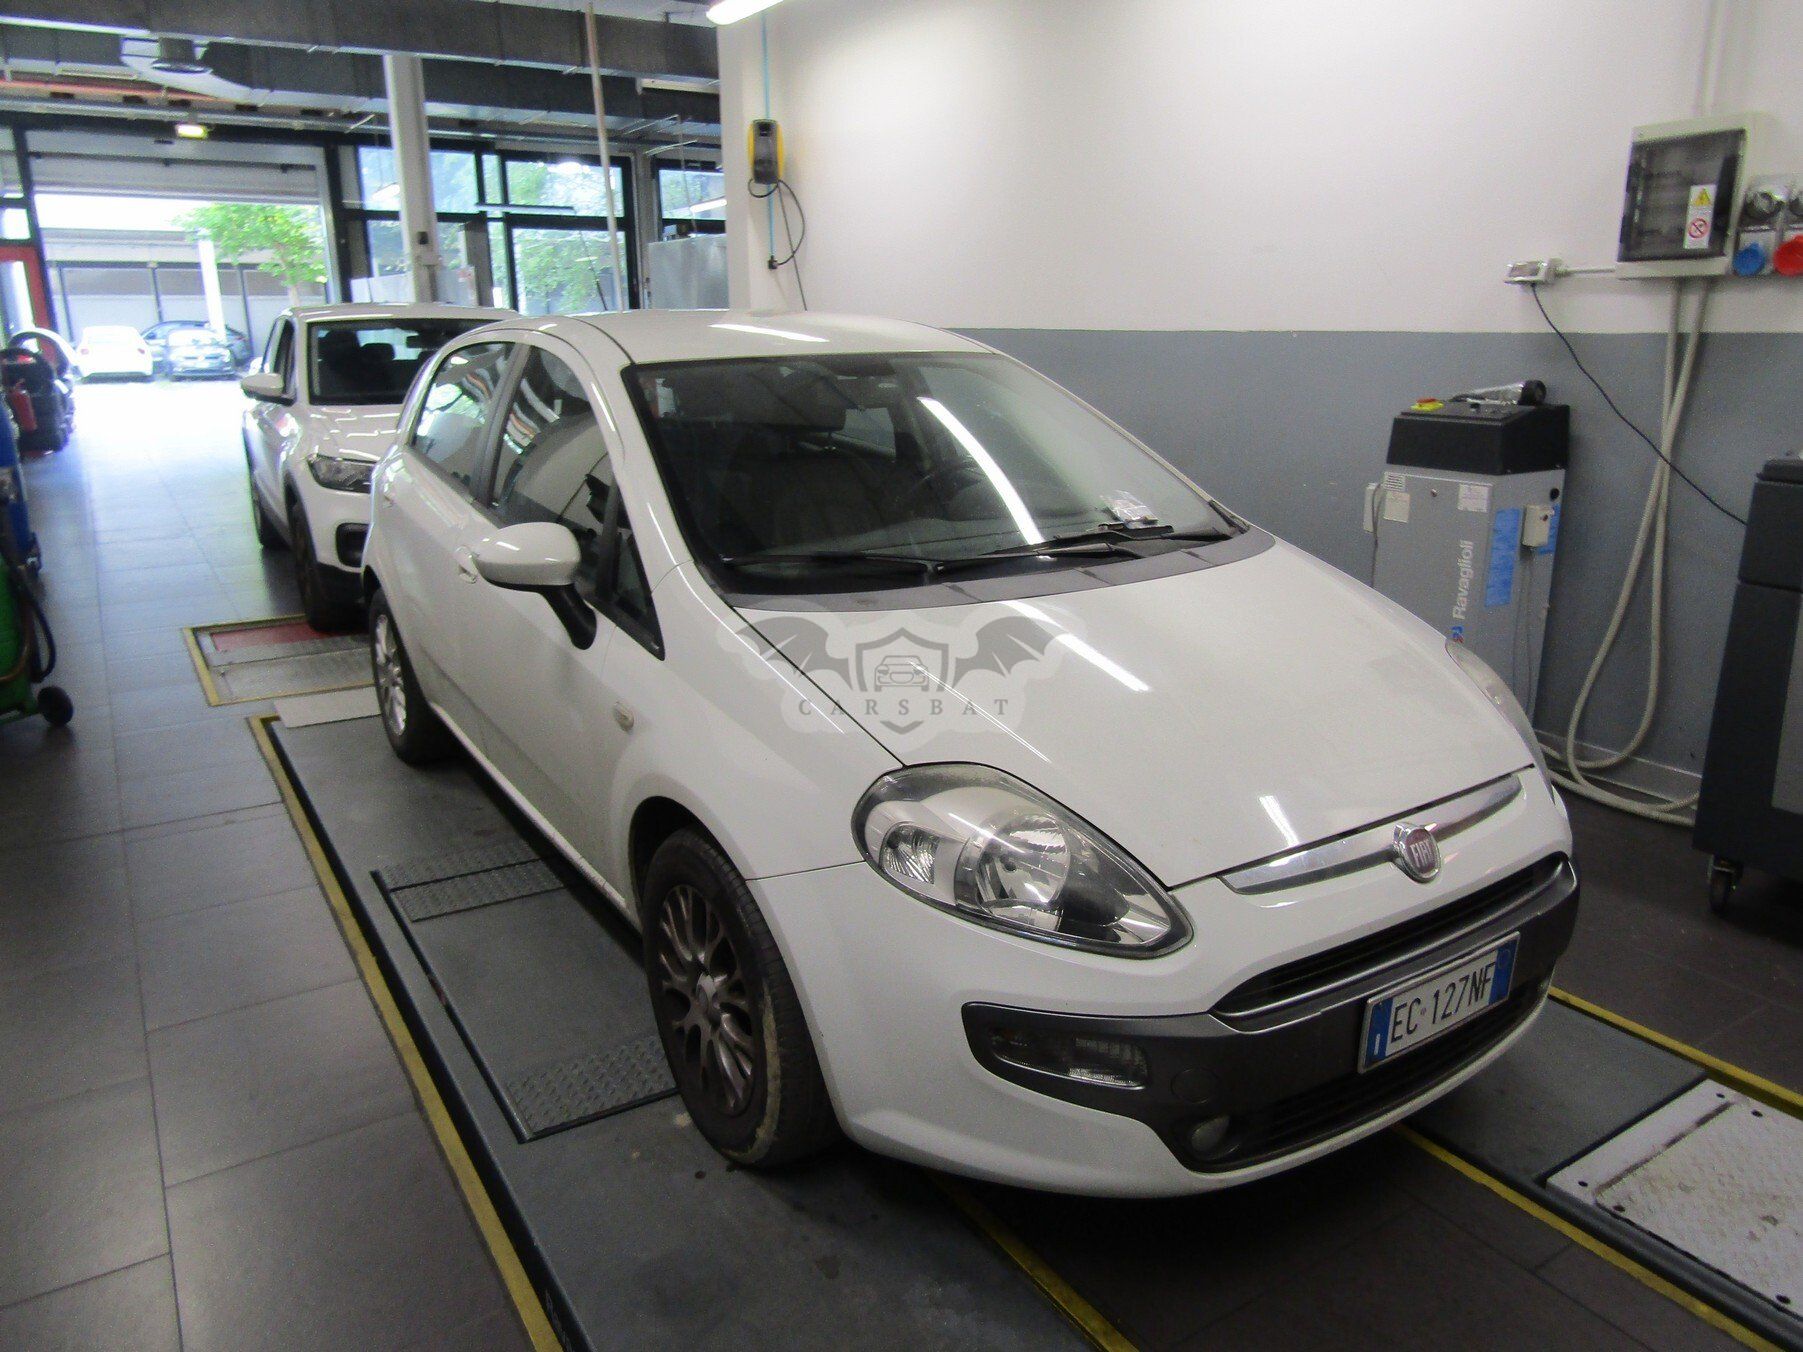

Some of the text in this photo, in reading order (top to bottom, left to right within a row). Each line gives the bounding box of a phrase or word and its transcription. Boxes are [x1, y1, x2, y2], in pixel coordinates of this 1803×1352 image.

[1410, 839, 1433, 868] FIAT
[1391, 961, 1496, 1043] EC 127NF
